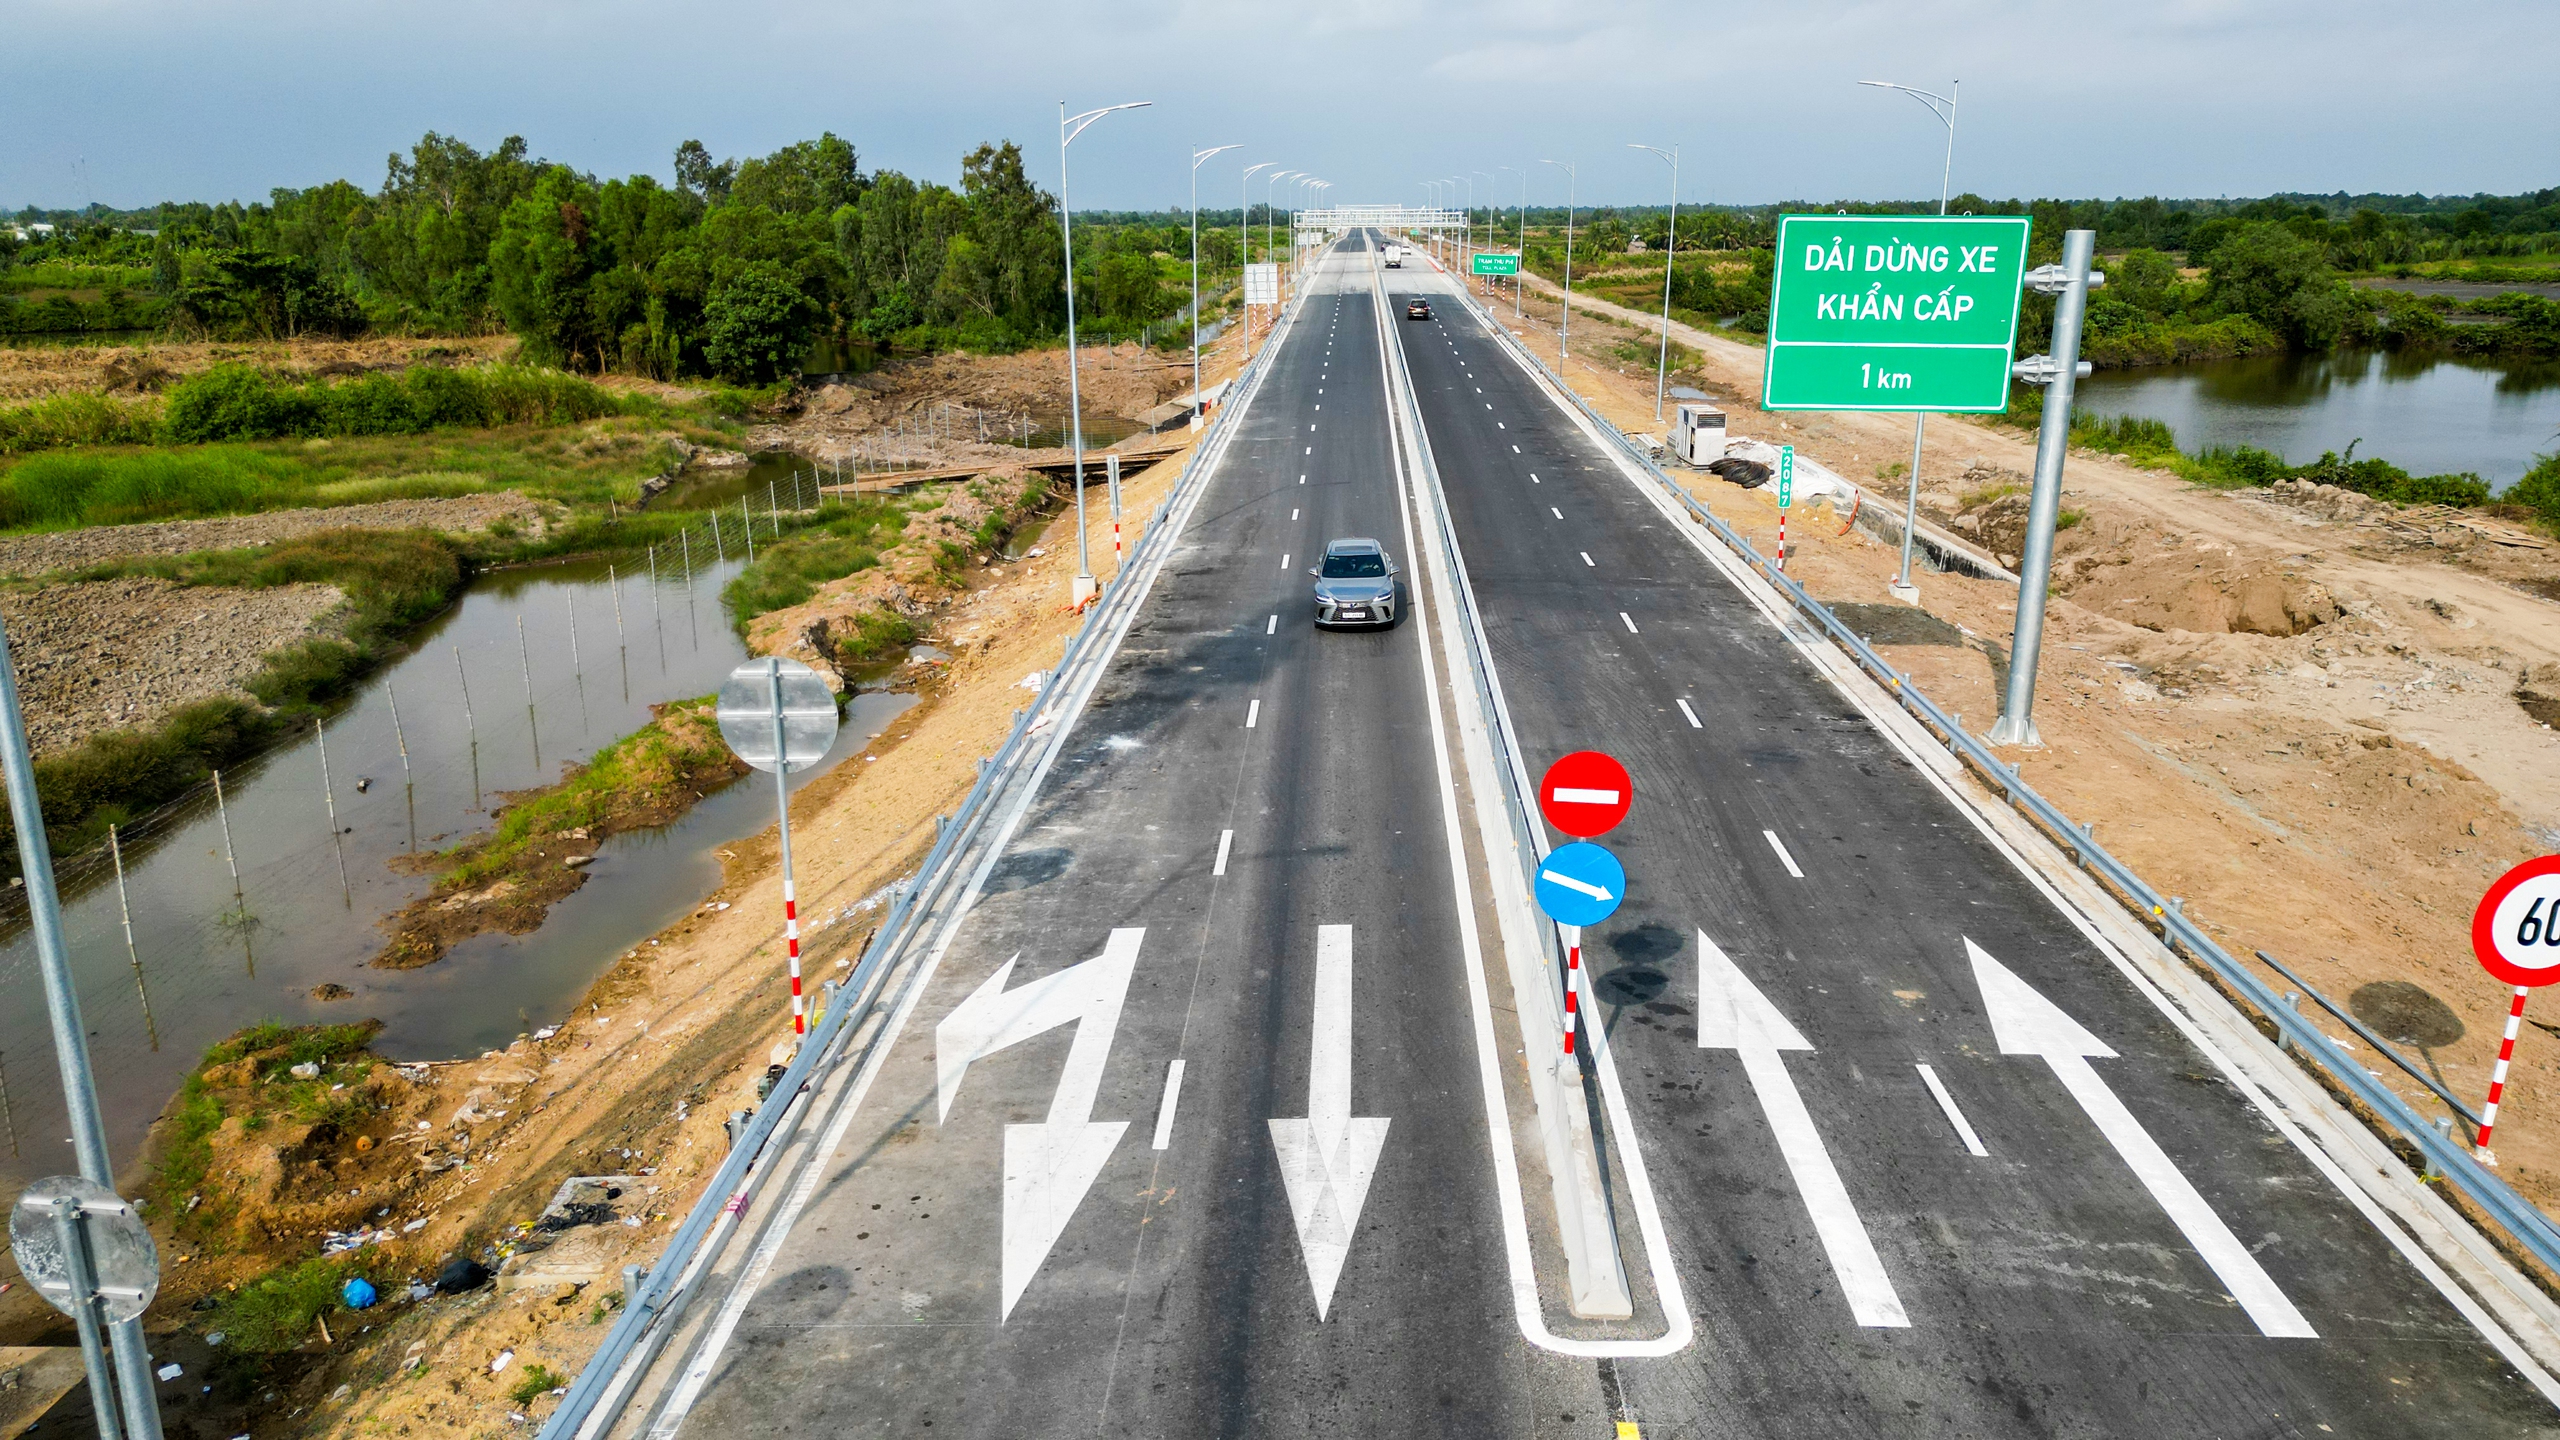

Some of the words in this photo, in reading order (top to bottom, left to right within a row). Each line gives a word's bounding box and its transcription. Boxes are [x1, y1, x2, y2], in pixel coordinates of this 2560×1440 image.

[1805, 236, 1855, 272] DẢI
[1865, 237, 1949, 273] DỪNG
[1957, 246, 1999, 273] XE
[1817, 282, 1904, 320] KHẨN
[1914, 285, 1974, 321] CẤP
[1861, 363, 1871, 388] 1
[1878, 368, 1912, 389] km
[1782, 456, 1791, 505] 2087
[2517, 897, 2560, 947] 60
